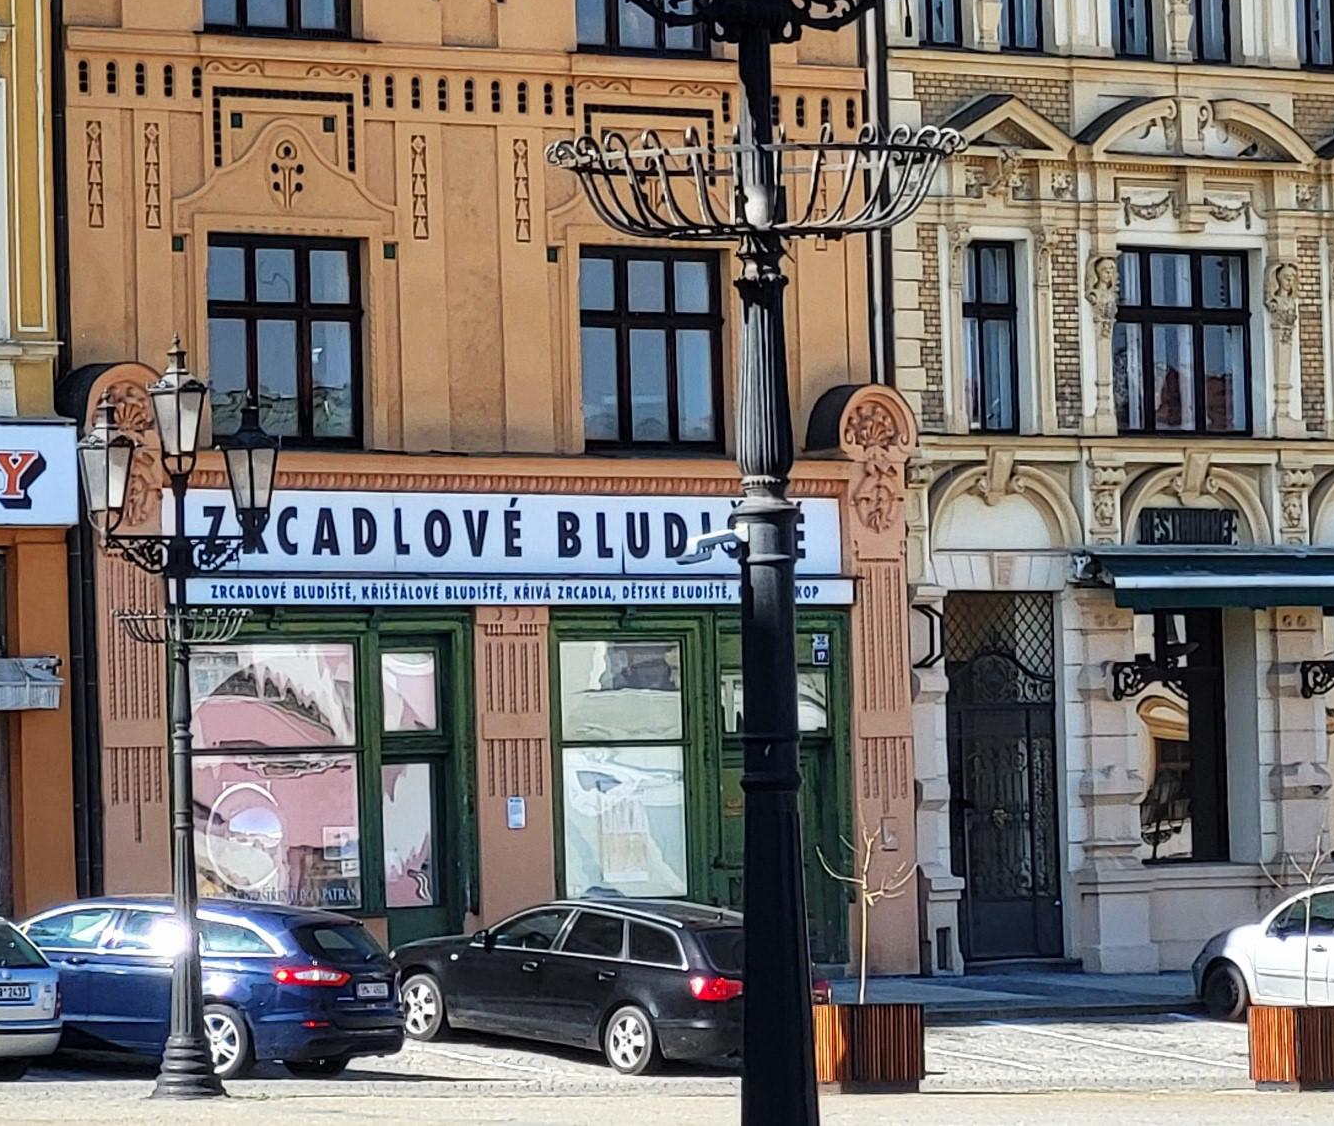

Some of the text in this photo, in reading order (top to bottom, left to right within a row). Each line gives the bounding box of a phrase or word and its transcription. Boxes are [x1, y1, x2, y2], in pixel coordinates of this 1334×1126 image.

[211, 582, 286, 599] ZRCADLOVÉ
[294, 582, 357, 602] BLUDIŠTĚ,
[362, 582, 439, 600] KŘIŠŤÁLOVÉ
[445, 582, 508, 602] BLUDIŠTĚ,
[514, 582, 551, 600] KŘIVÁ
[558, 585, 616, 602] ZRCADLA,
[623, 582, 666, 599] DĚTSKÉ
[672, 582, 732, 601] BLUDIŠTĚ,
